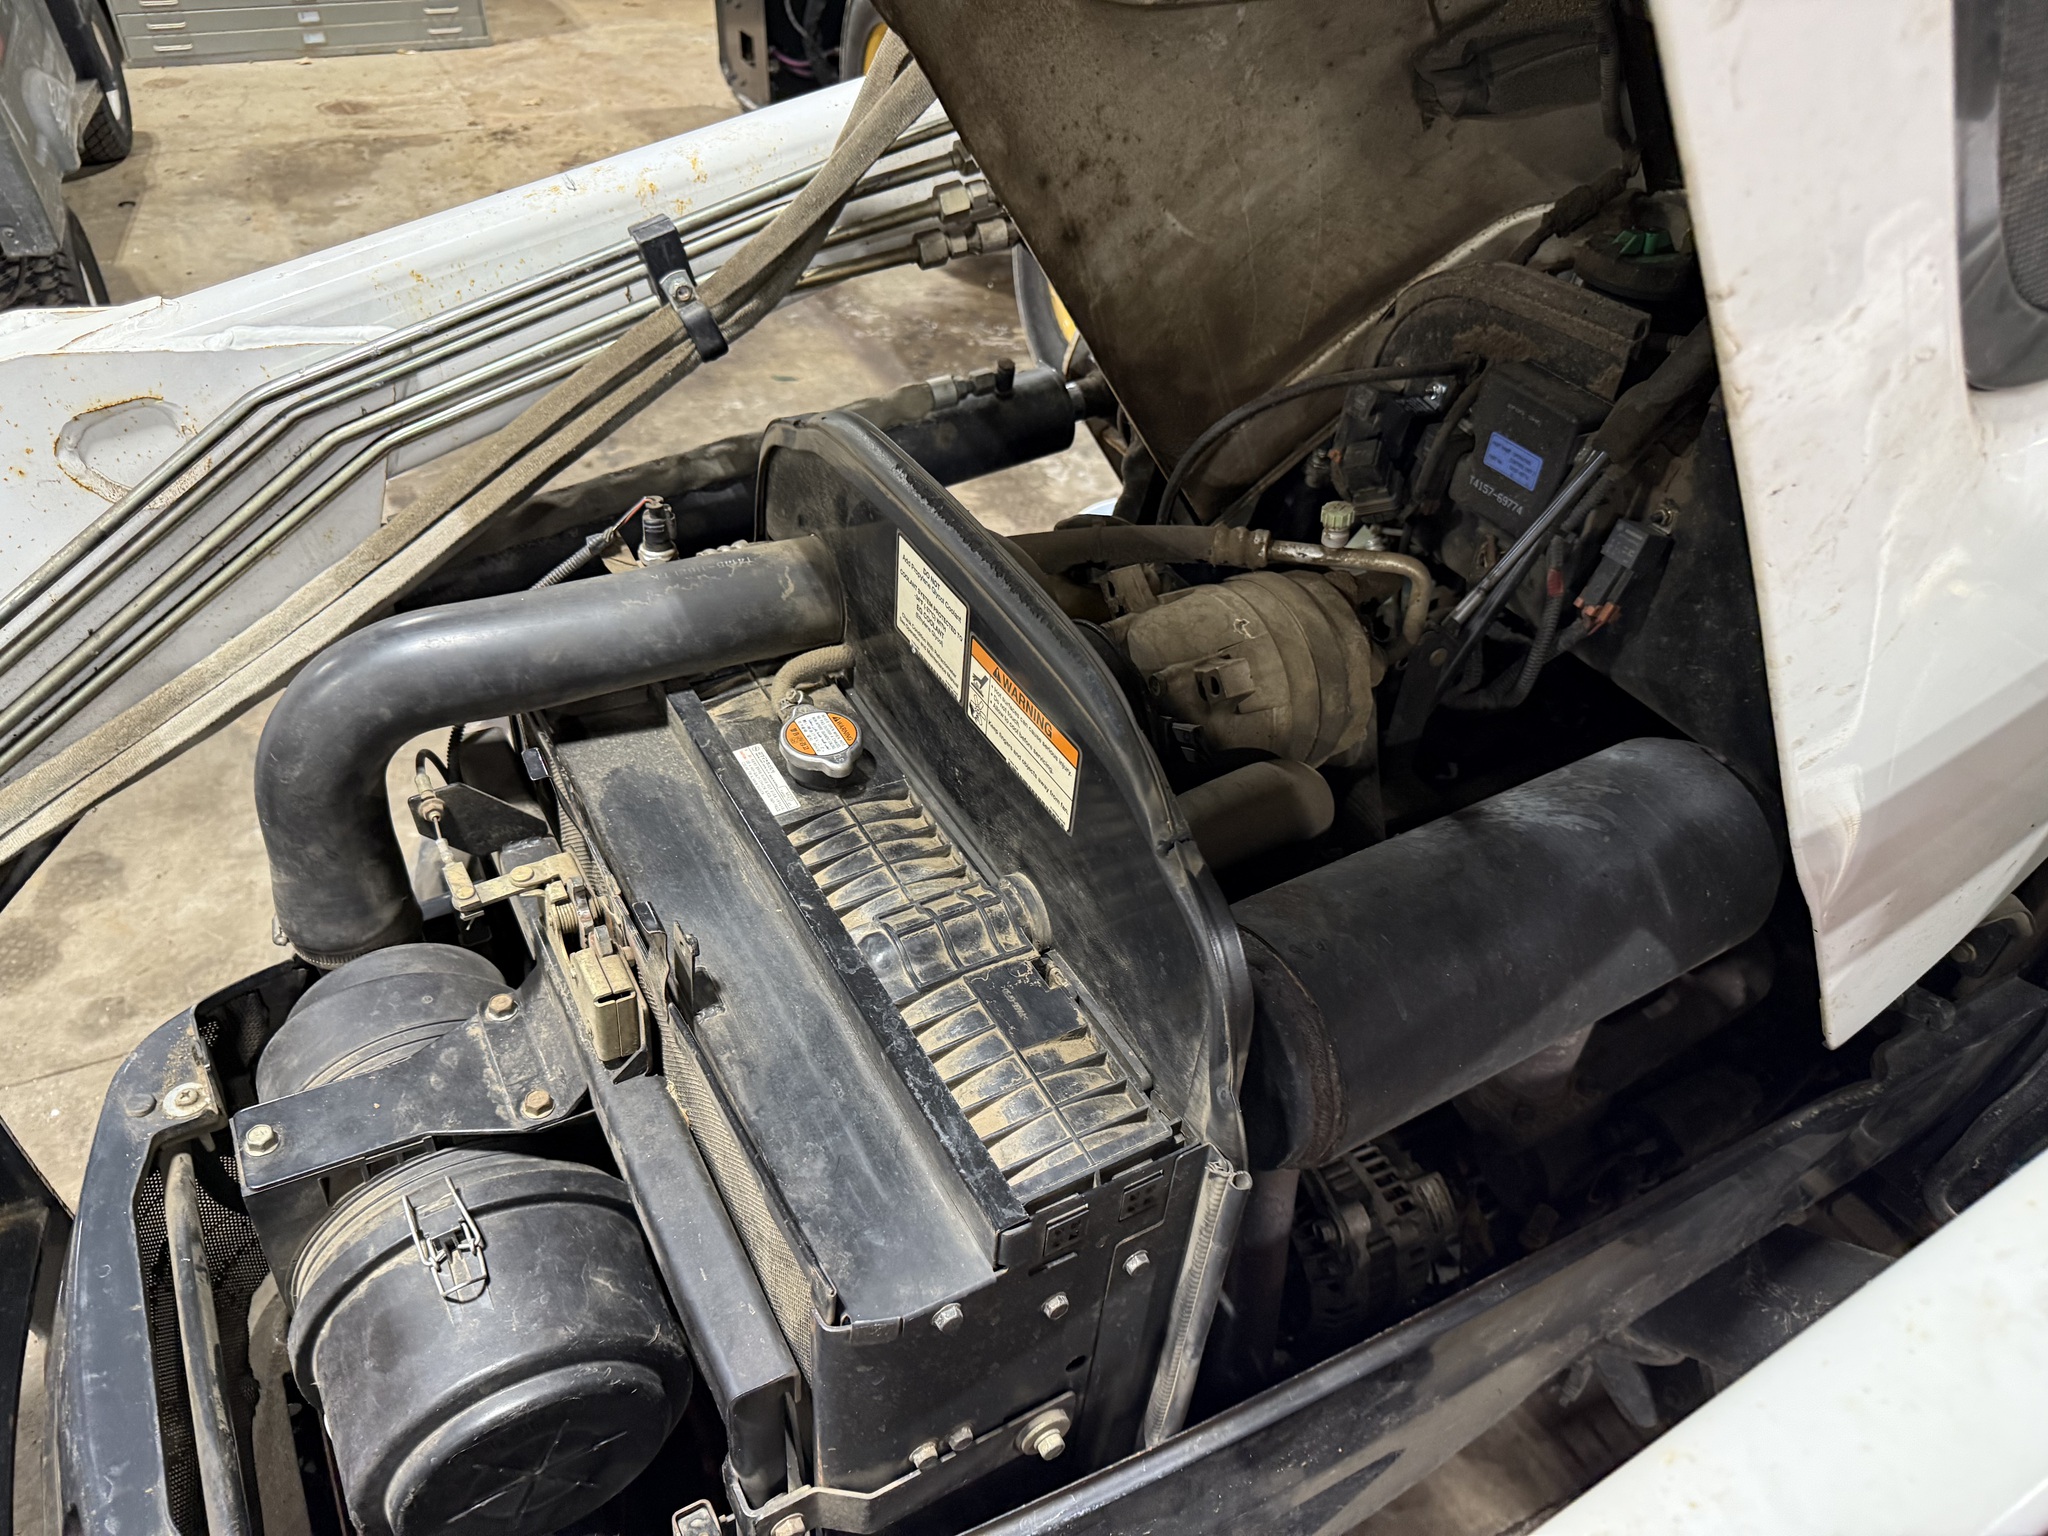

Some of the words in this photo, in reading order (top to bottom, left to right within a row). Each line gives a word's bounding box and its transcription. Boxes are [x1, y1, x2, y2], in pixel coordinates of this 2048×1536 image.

[899, 566, 917, 592] COOLANT
[917, 586, 932, 609] SYSTEM
[932, 604, 956, 636] PROTECTED
[956, 630, 963, 643] TO
[902, 552, 911, 568] Add
[910, 561, 931, 592] Propylene
[931, 584, 944, 606] Glycol
[944, 599, 962, 624] Coolant
[922, 565, 930, 580] DO
[930, 574, 940, 592] NOT
[922, 610, 944, 640] COOLANT
[992, 694, 999, 706] Do
[992, 701, 1003, 718] Allow
[1003, 714, 1008, 724] to
[1008, 720, 1018, 735] cool
[1018, 731, 1032, 751] before
[993, 686, 1001, 699] Hot
[1001, 694, 1019, 720] surfaces
[1019, 715, 1028, 729] can
[1028, 725, 1041, 744] cause
[1041, 739, 1058, 762] serious
[1001, 672, 1053, 739] WARNING
[987, 719, 998, 736] Keep
[998, 731, 1012, 752] fingers
[1013, 748, 1021, 761] and
[1021, 757, 1037, 781] objects
[1037, 777, 1049, 795] away
[1049, 789, 1060, 806] from
